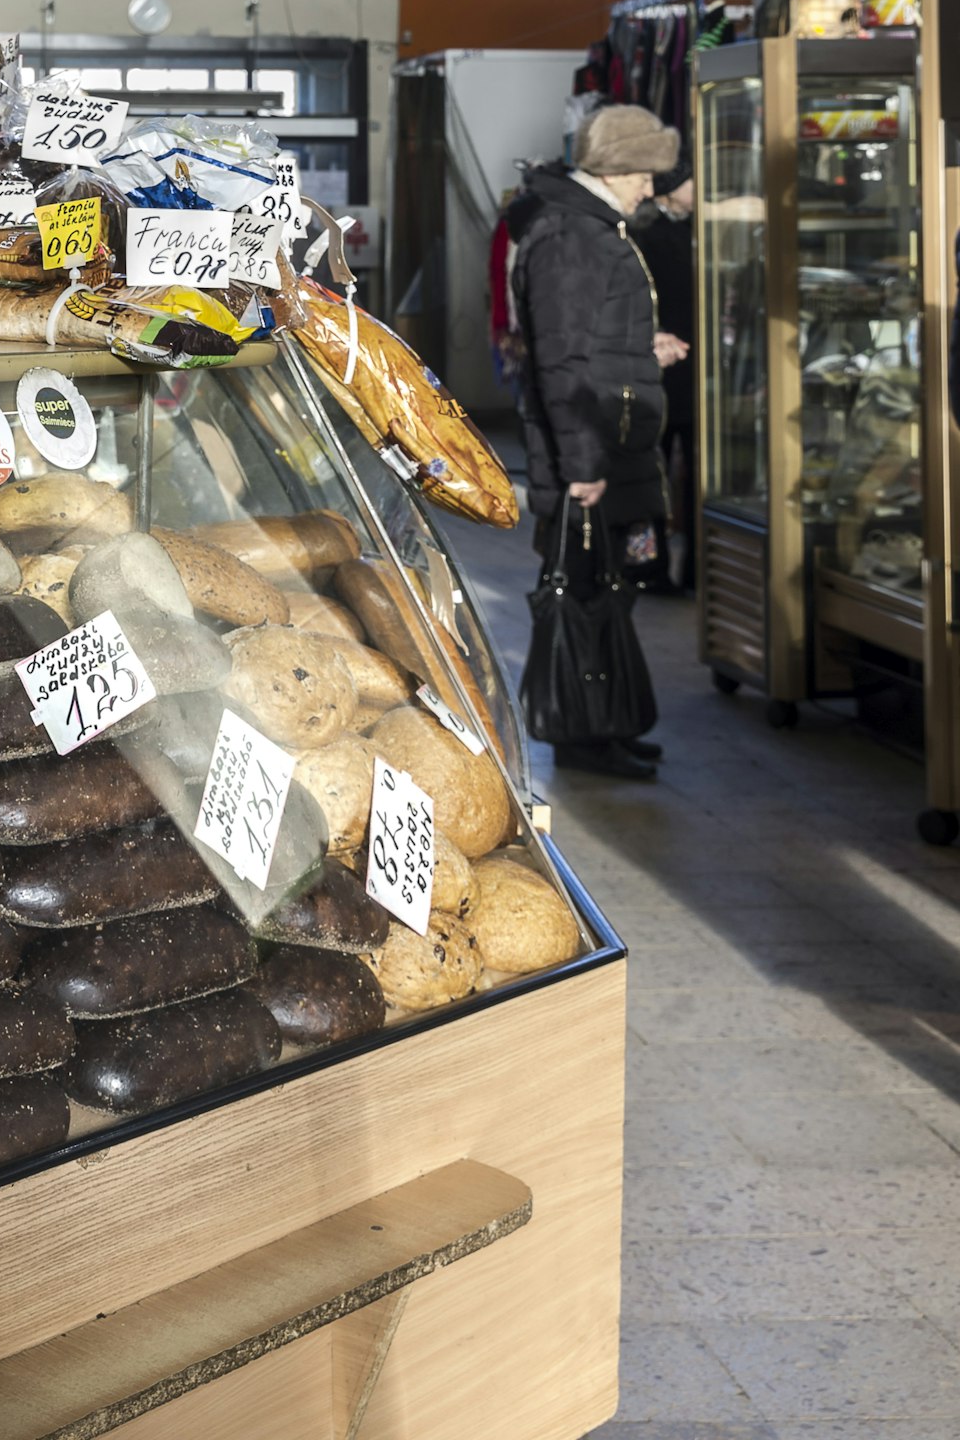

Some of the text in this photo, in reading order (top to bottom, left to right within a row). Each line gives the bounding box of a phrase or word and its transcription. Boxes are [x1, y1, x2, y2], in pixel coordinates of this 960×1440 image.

[134, 215, 229, 253] Franču
[35, 400, 70, 415] super
[40, 415, 76, 428] Saimniece
